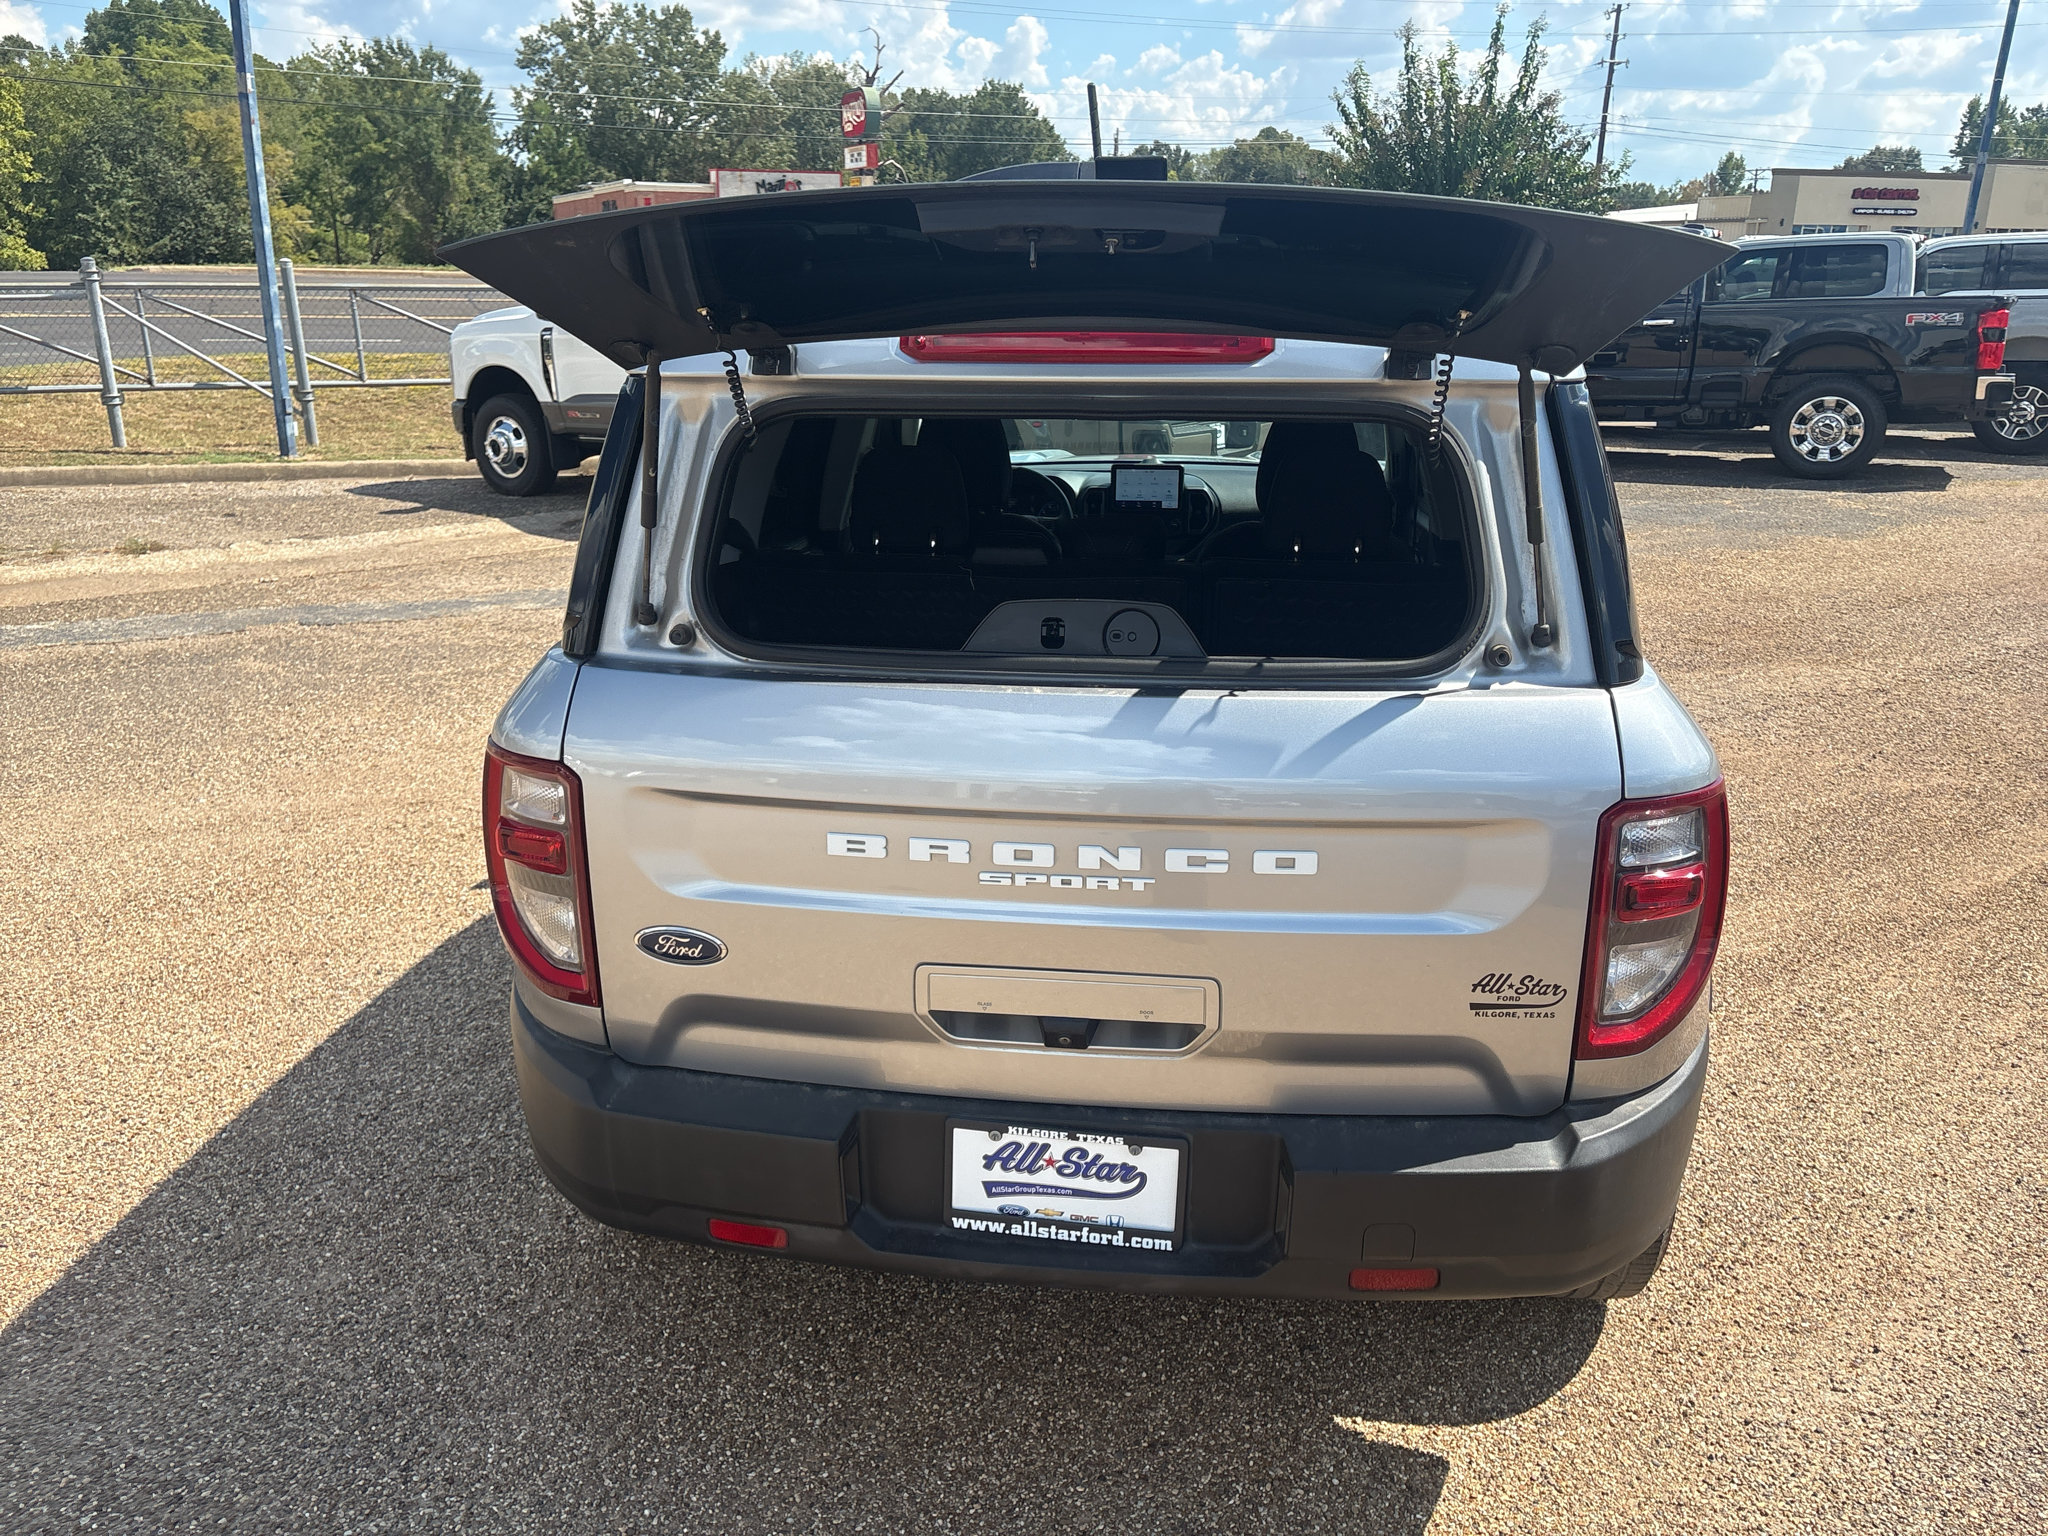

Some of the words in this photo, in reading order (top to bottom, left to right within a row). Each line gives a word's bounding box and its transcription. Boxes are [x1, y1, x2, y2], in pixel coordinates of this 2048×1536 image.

[1905, 312, 1963, 326] FX4
[826, 831, 1319, 875] BRONCO
[977, 870, 1156, 891] SPORT
[654, 934, 704, 958] Ford
[1474, 1010, 1520, 1019] KILGORE,
[1524, 1011, 1556, 1019] TEXAS
[1007, 1126, 1073, 1141] KILGORE,
[1076, 1133, 1125, 1145] TEXAS
[991, 1185, 1074, 1197] AllStarGroupTexas.com
[1070, 1213, 1099, 1223] GMC
[951, 1216, 1173, 1251] www.allstarford.com
